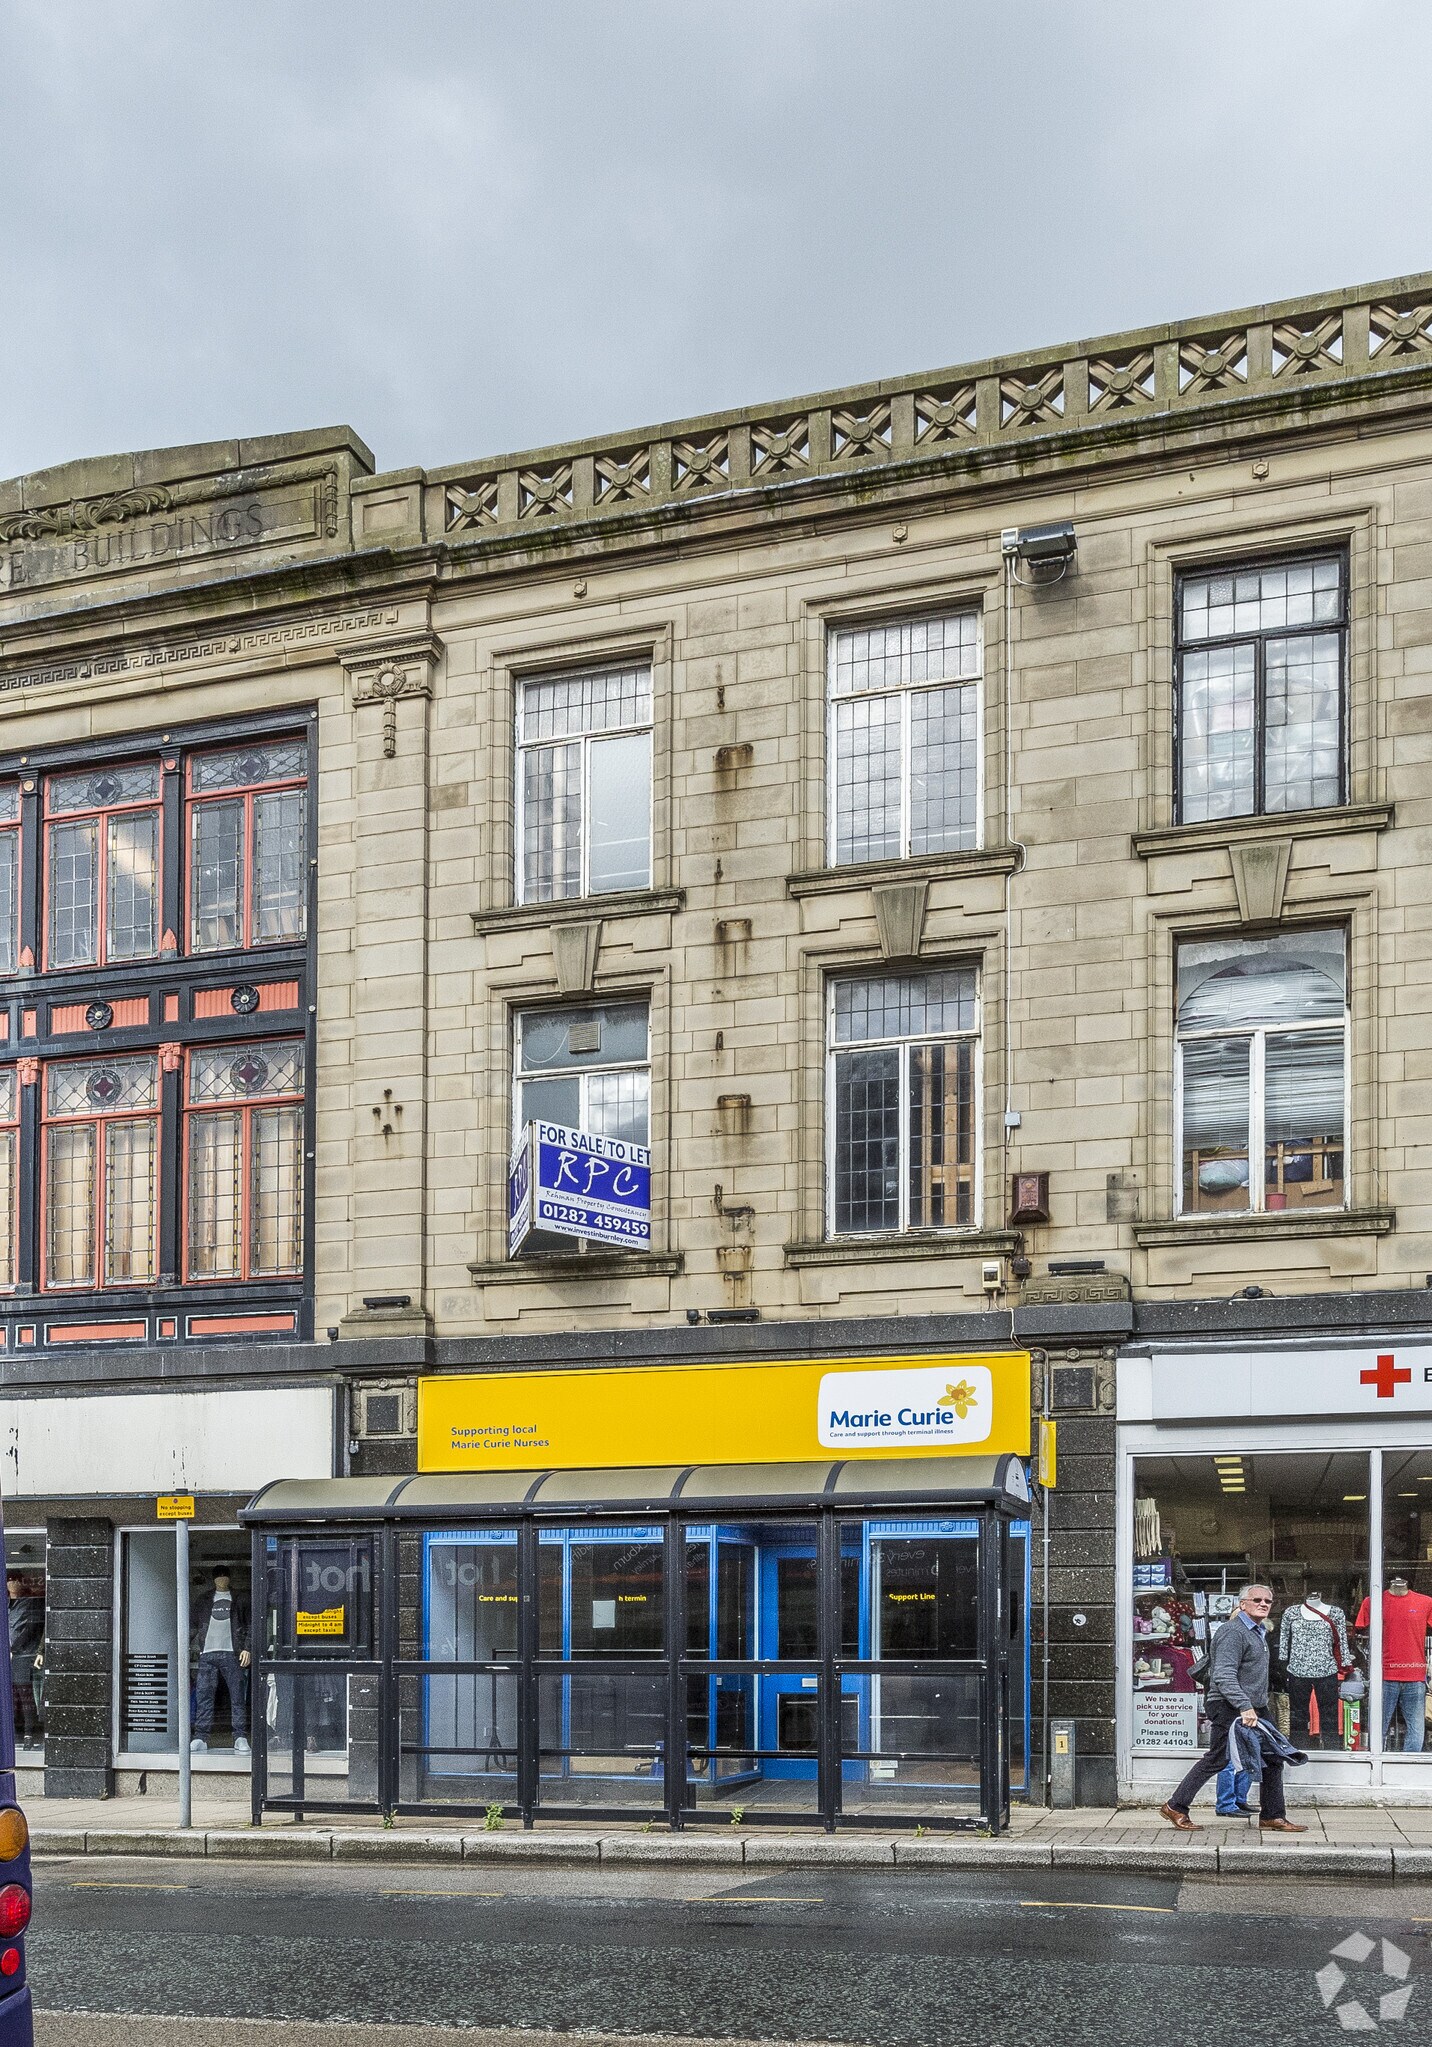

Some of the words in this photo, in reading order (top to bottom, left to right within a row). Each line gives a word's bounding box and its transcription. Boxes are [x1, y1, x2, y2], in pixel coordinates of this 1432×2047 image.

[73, 504, 263, 572] BUILDINGS
[540, 1124, 567, 1146] FOR
[571, 1132, 626, 1160] SALE/TO
[630, 1146, 651, 1166] LET
[577, 1196, 605, 1211] Property
[543, 1203, 588, 1225] 01282
[594, 1215, 649, 1236] 459459
[554, 1224, 639, 1246] www.investinburnley.com
[829, 1409, 892, 1428] Marie
[897, 1407, 954, 1426] Curie
[451, 1426, 510, 1437] Supporting
[512, 1424, 537, 1434] local
[857, 1430, 881, 1438] support
[881, 1429, 907, 1438] through
[451, 1439, 481, 1449] Marie
[483, 1439, 511, 1448] Curie
[513, 1438, 550, 1447] Nurses
[478, 1594, 494, 1602] Care
[495, 1594, 508, 1602] and
[889, 1593, 918, 1602] Support
[1141, 1728, 1169, 1736] Please
[1171, 1729, 1189, 1737] ring
